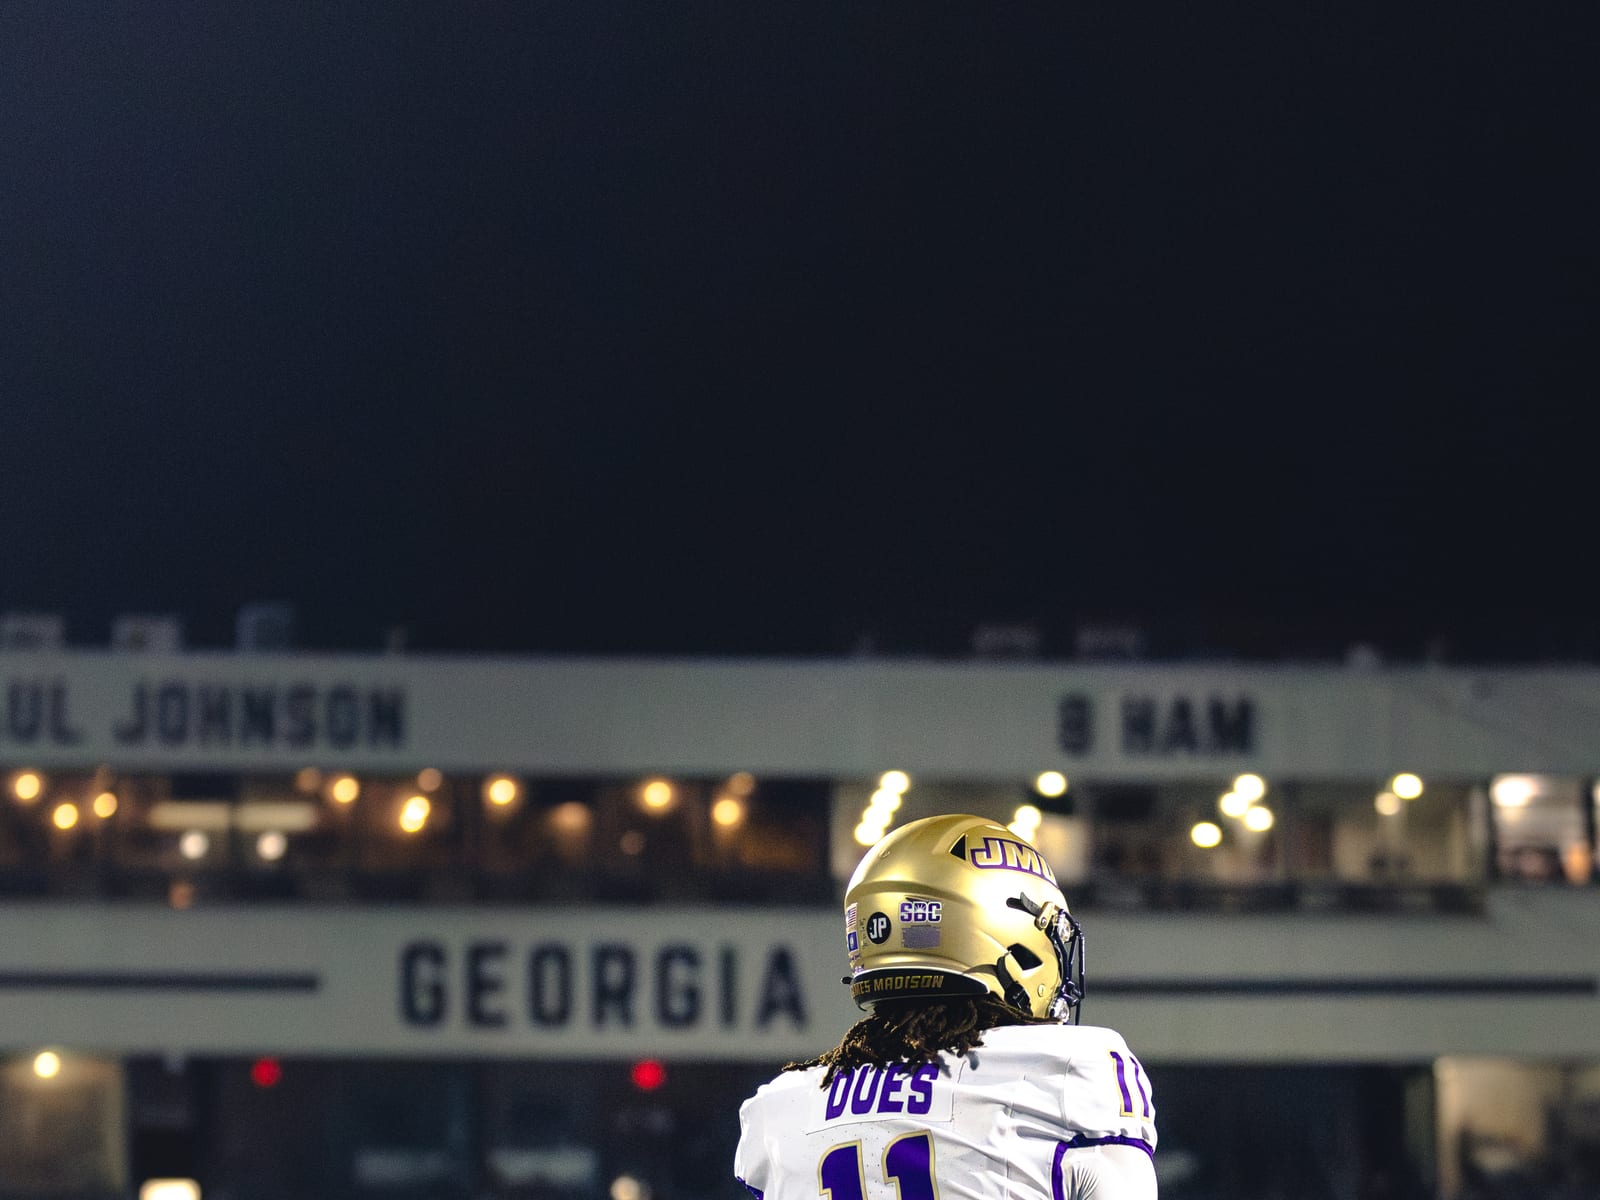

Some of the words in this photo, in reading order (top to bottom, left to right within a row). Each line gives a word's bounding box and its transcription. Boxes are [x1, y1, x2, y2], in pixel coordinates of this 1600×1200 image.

[113, 676, 408, 752] JOHNSON
[1120, 692, 1257, 756] HAM
[869, 917, 887, 939] JP
[900, 902, 941, 922] SBC
[401, 942, 808, 1031] GEORGIA
[873, 975, 944, 992] MADISON
[825, 1062, 940, 1120] DUES
